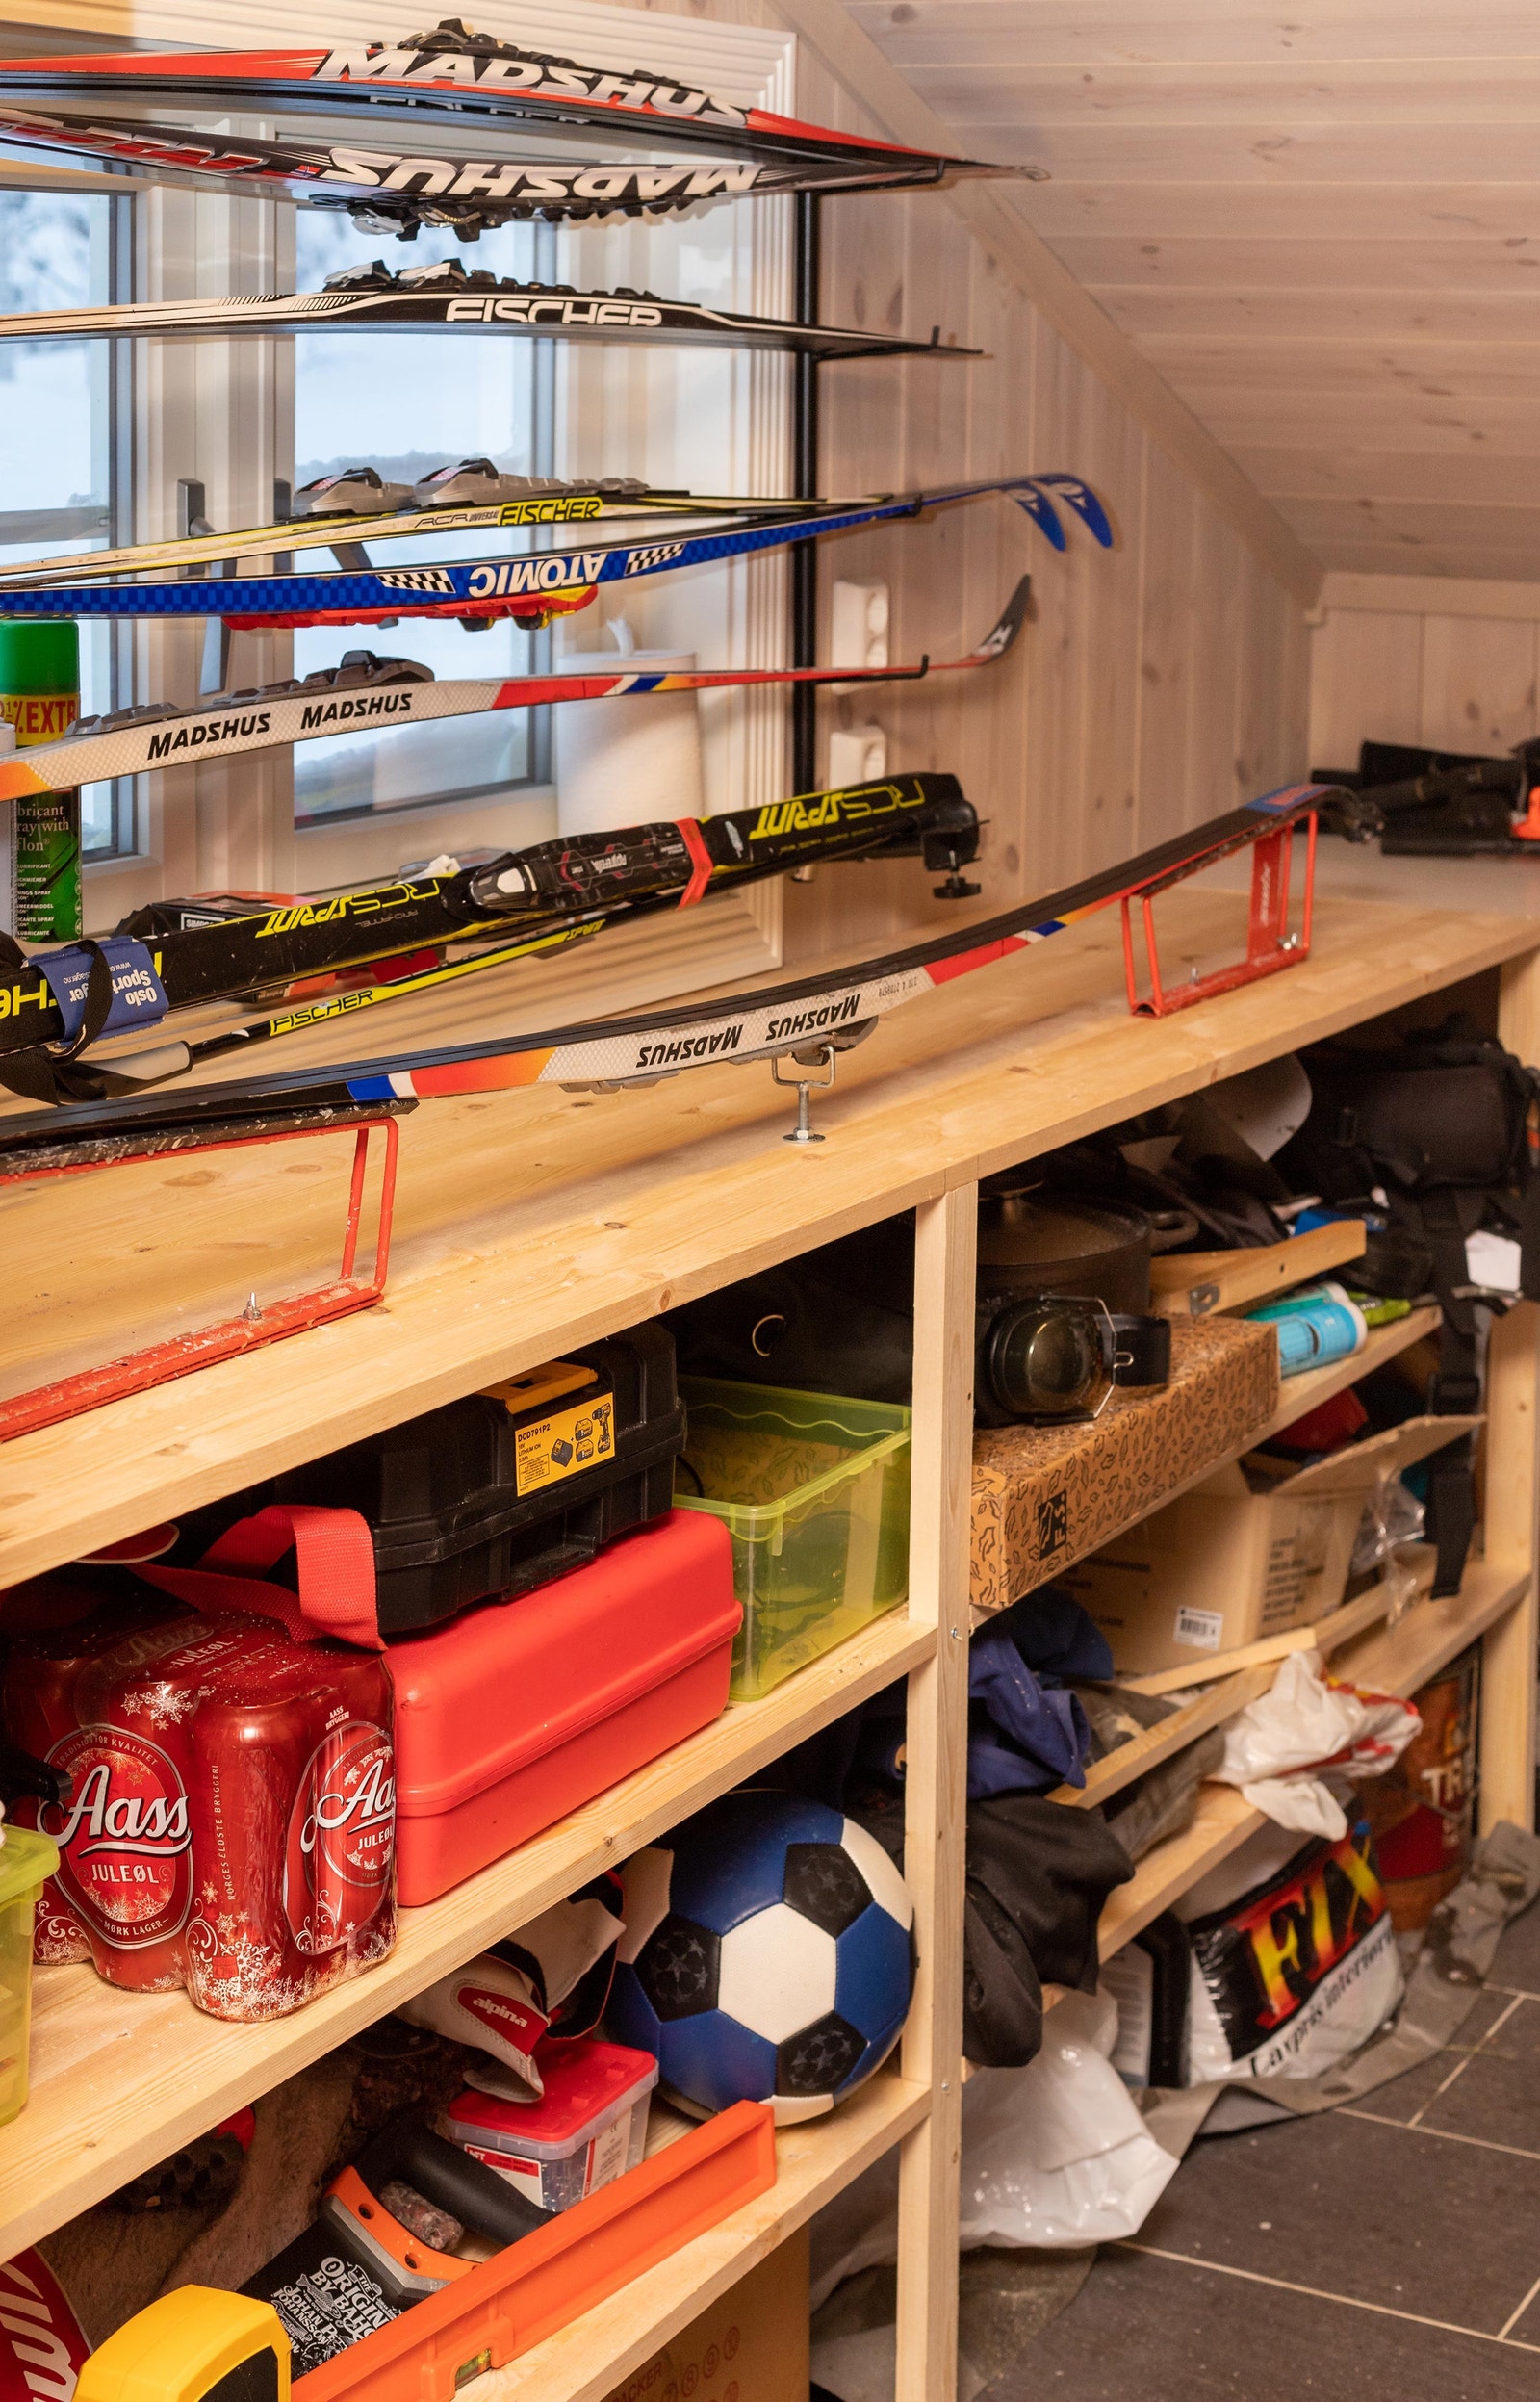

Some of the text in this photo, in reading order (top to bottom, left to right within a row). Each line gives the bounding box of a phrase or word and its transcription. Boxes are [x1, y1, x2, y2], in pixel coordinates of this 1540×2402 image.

[310, 48, 751, 129] MADSHUS
[319, 146, 764, 198] MADSHUS
[446, 299, 662, 327] FISCHER
[500, 500, 602, 526] FISCHER
[468, 553, 608, 599] ATOMIC
[147, 693, 412, 761] MADSHUS MADSHUS
[17, 803, 64, 816] bricant
[42, 820, 70, 832] with
[125, 987, 158, 1007] Oslo
[273, 990, 373, 1032] FISCHER
[636, 994, 860, 1068] MADSHUS MADSHUS
[518, 1424, 551, 1443] DCD791P2
[329, 1705, 344, 1720] AASS
[111, 1738, 159, 1766] KVALITET
[212, 1765, 222, 1814] BRYGGERI
[37, 1764, 190, 1847] Aass
[216, 1819, 226, 1859] ELDSTE
[91, 1864, 160, 1884] JULEØL
[104, 1919, 164, 1936] MØRK LAGER
[472, 1997, 528, 2028] alpina
[309, 2270, 338, 2293] BY
[321, 2256, 390, 2329] ORIGIN
[357, 2273, 372, 2293] THE
[270, 2287, 330, 2345] JOHANSSON
[282, 2285, 324, 2326] JOHAN
